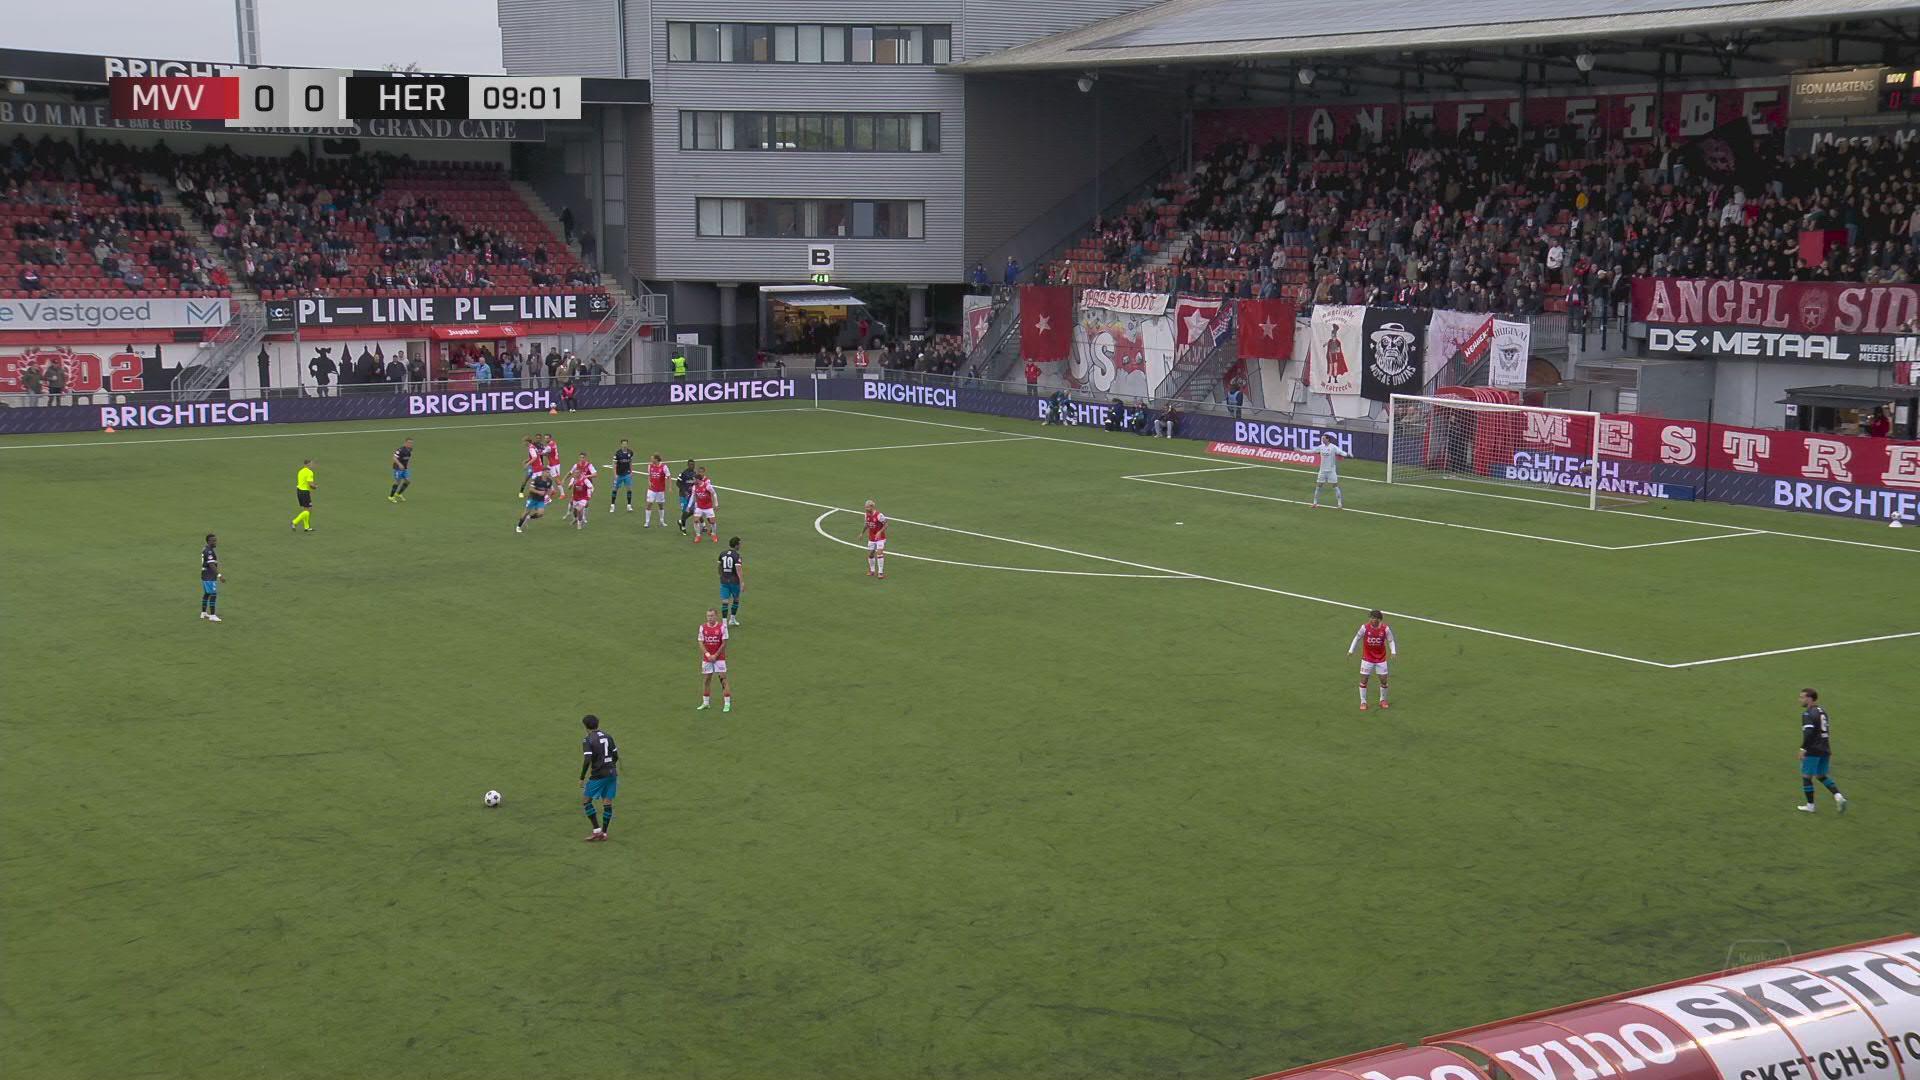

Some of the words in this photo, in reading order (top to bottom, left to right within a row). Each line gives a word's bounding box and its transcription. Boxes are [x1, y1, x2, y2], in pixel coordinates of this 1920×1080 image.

[1796, 83, 1823, 95] LEON
[1824, 80, 1874, 93] MARTENS
[369, 119, 453, 137] GRAND
[812, 249, 830, 265] B
[18, 301, 151, 326] Vastgoed
[1646, 280, 1790, 328] ANGEL
[1858, 352, 1888, 363] MEETS
[1859, 343, 1890, 353] WHERE
[670, 379, 795, 402] BRIGHTECH
[864, 382, 957, 407] BRIGHTECH
[410, 391, 551, 415] BRIGHTECH
[101, 402, 269, 427] BRIGHTECH
[1214, 442, 1258, 457] Keuken
[1256, 447, 1315, 464] Kampioen
[1774, 479, 1920, 521] BRIGHTE
[721, 555, 734, 569] 10
[599, 738, 609, 756] 7
